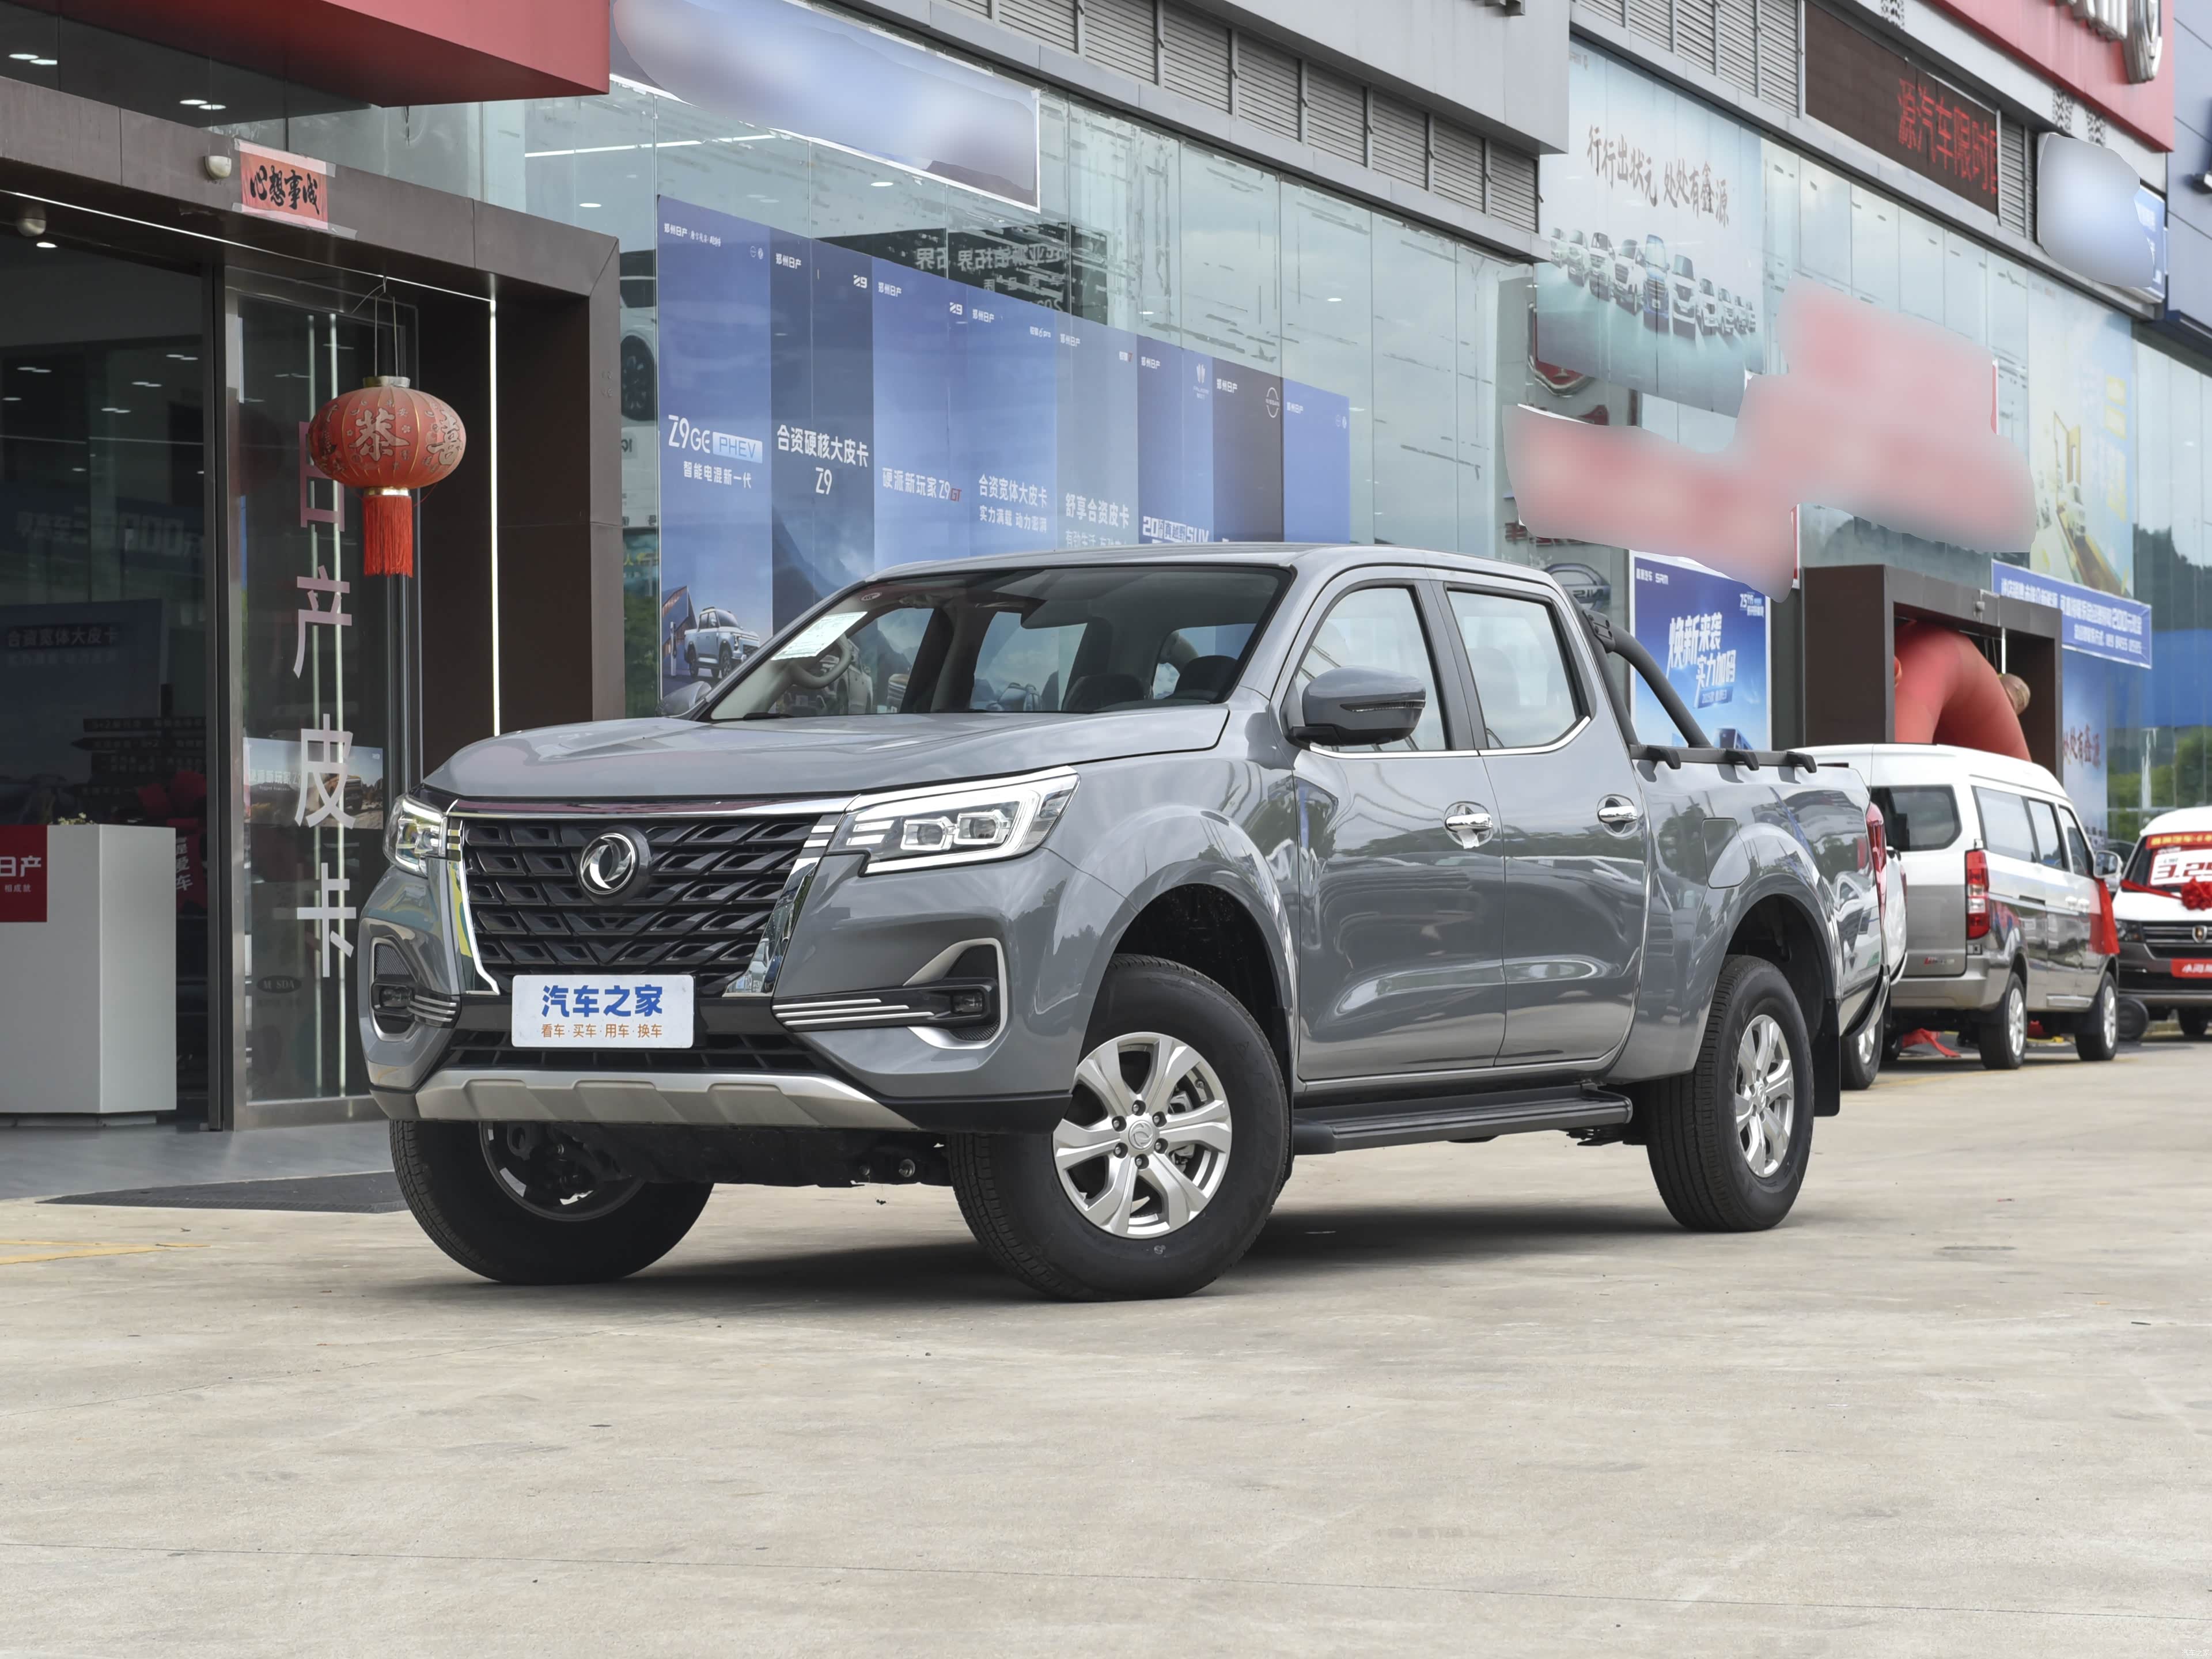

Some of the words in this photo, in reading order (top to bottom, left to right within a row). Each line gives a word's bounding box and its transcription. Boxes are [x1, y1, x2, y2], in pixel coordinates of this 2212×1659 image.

[1588, 124, 1658, 207] 行行出状元
[250, 165, 320, 215] 心想事成
[775, 253, 801, 269] 郑州日产
[878, 282, 902, 297] 郑州日产
[719, 436, 756, 459] PHEV
[777, 425, 869, 467] 合资硬核大皮卡
[683, 461, 752, 489] 智能电混新一代
[815, 467, 832, 495] Z9
[882, 467, 937, 499] 硬派新玩家
[979, 474, 1047, 508] 合资宽体大皮卡
[1065, 493, 1130, 529] 舒享合资皮卡
[541, 984, 663, 1018] 汽车之家
[541, 1023, 565, 1038] 看车
[573, 1024, 597, 1038] 买车
[605, 1024, 630, 1038] 用车
[637, 1024, 662, 1038] 换车
